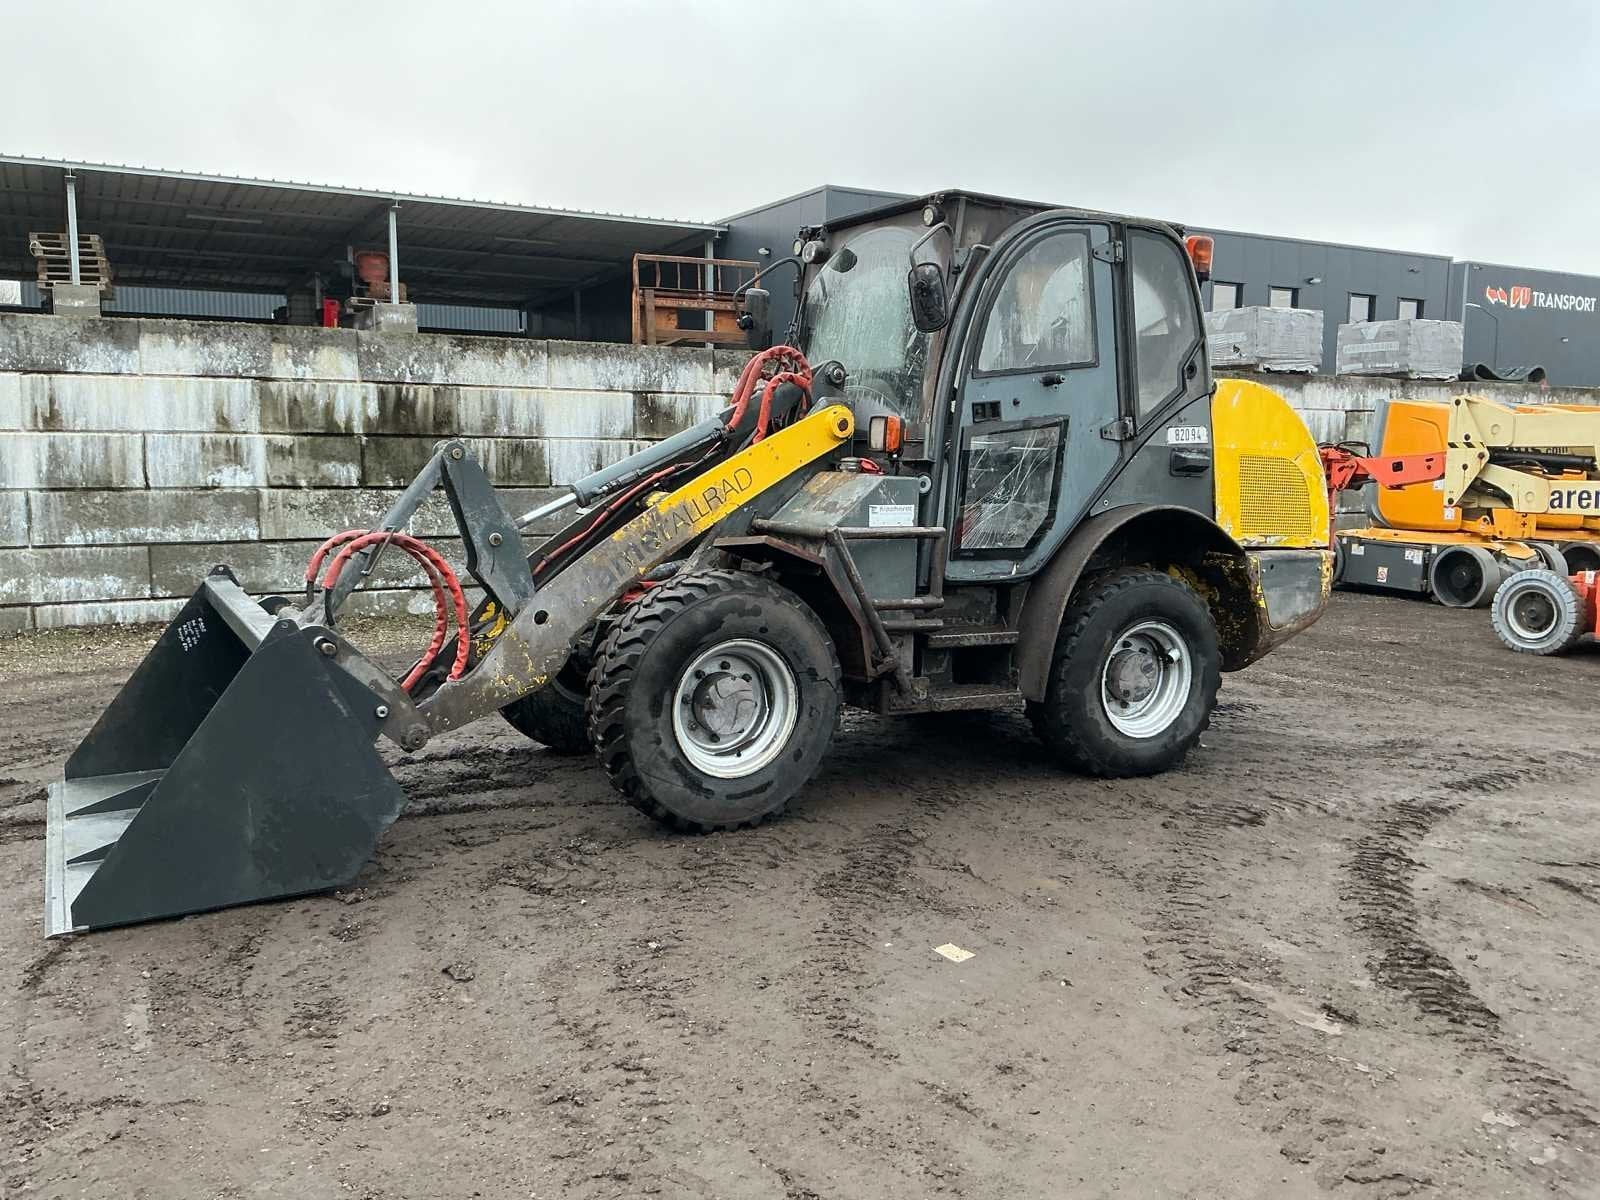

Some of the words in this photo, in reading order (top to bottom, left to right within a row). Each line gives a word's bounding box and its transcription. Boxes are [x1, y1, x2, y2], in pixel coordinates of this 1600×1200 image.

[1533, 291, 1597, 312] TRANSPORT
[1174, 428, 1202, 441] 82094
[671, 466, 753, 535] ALLRAD
